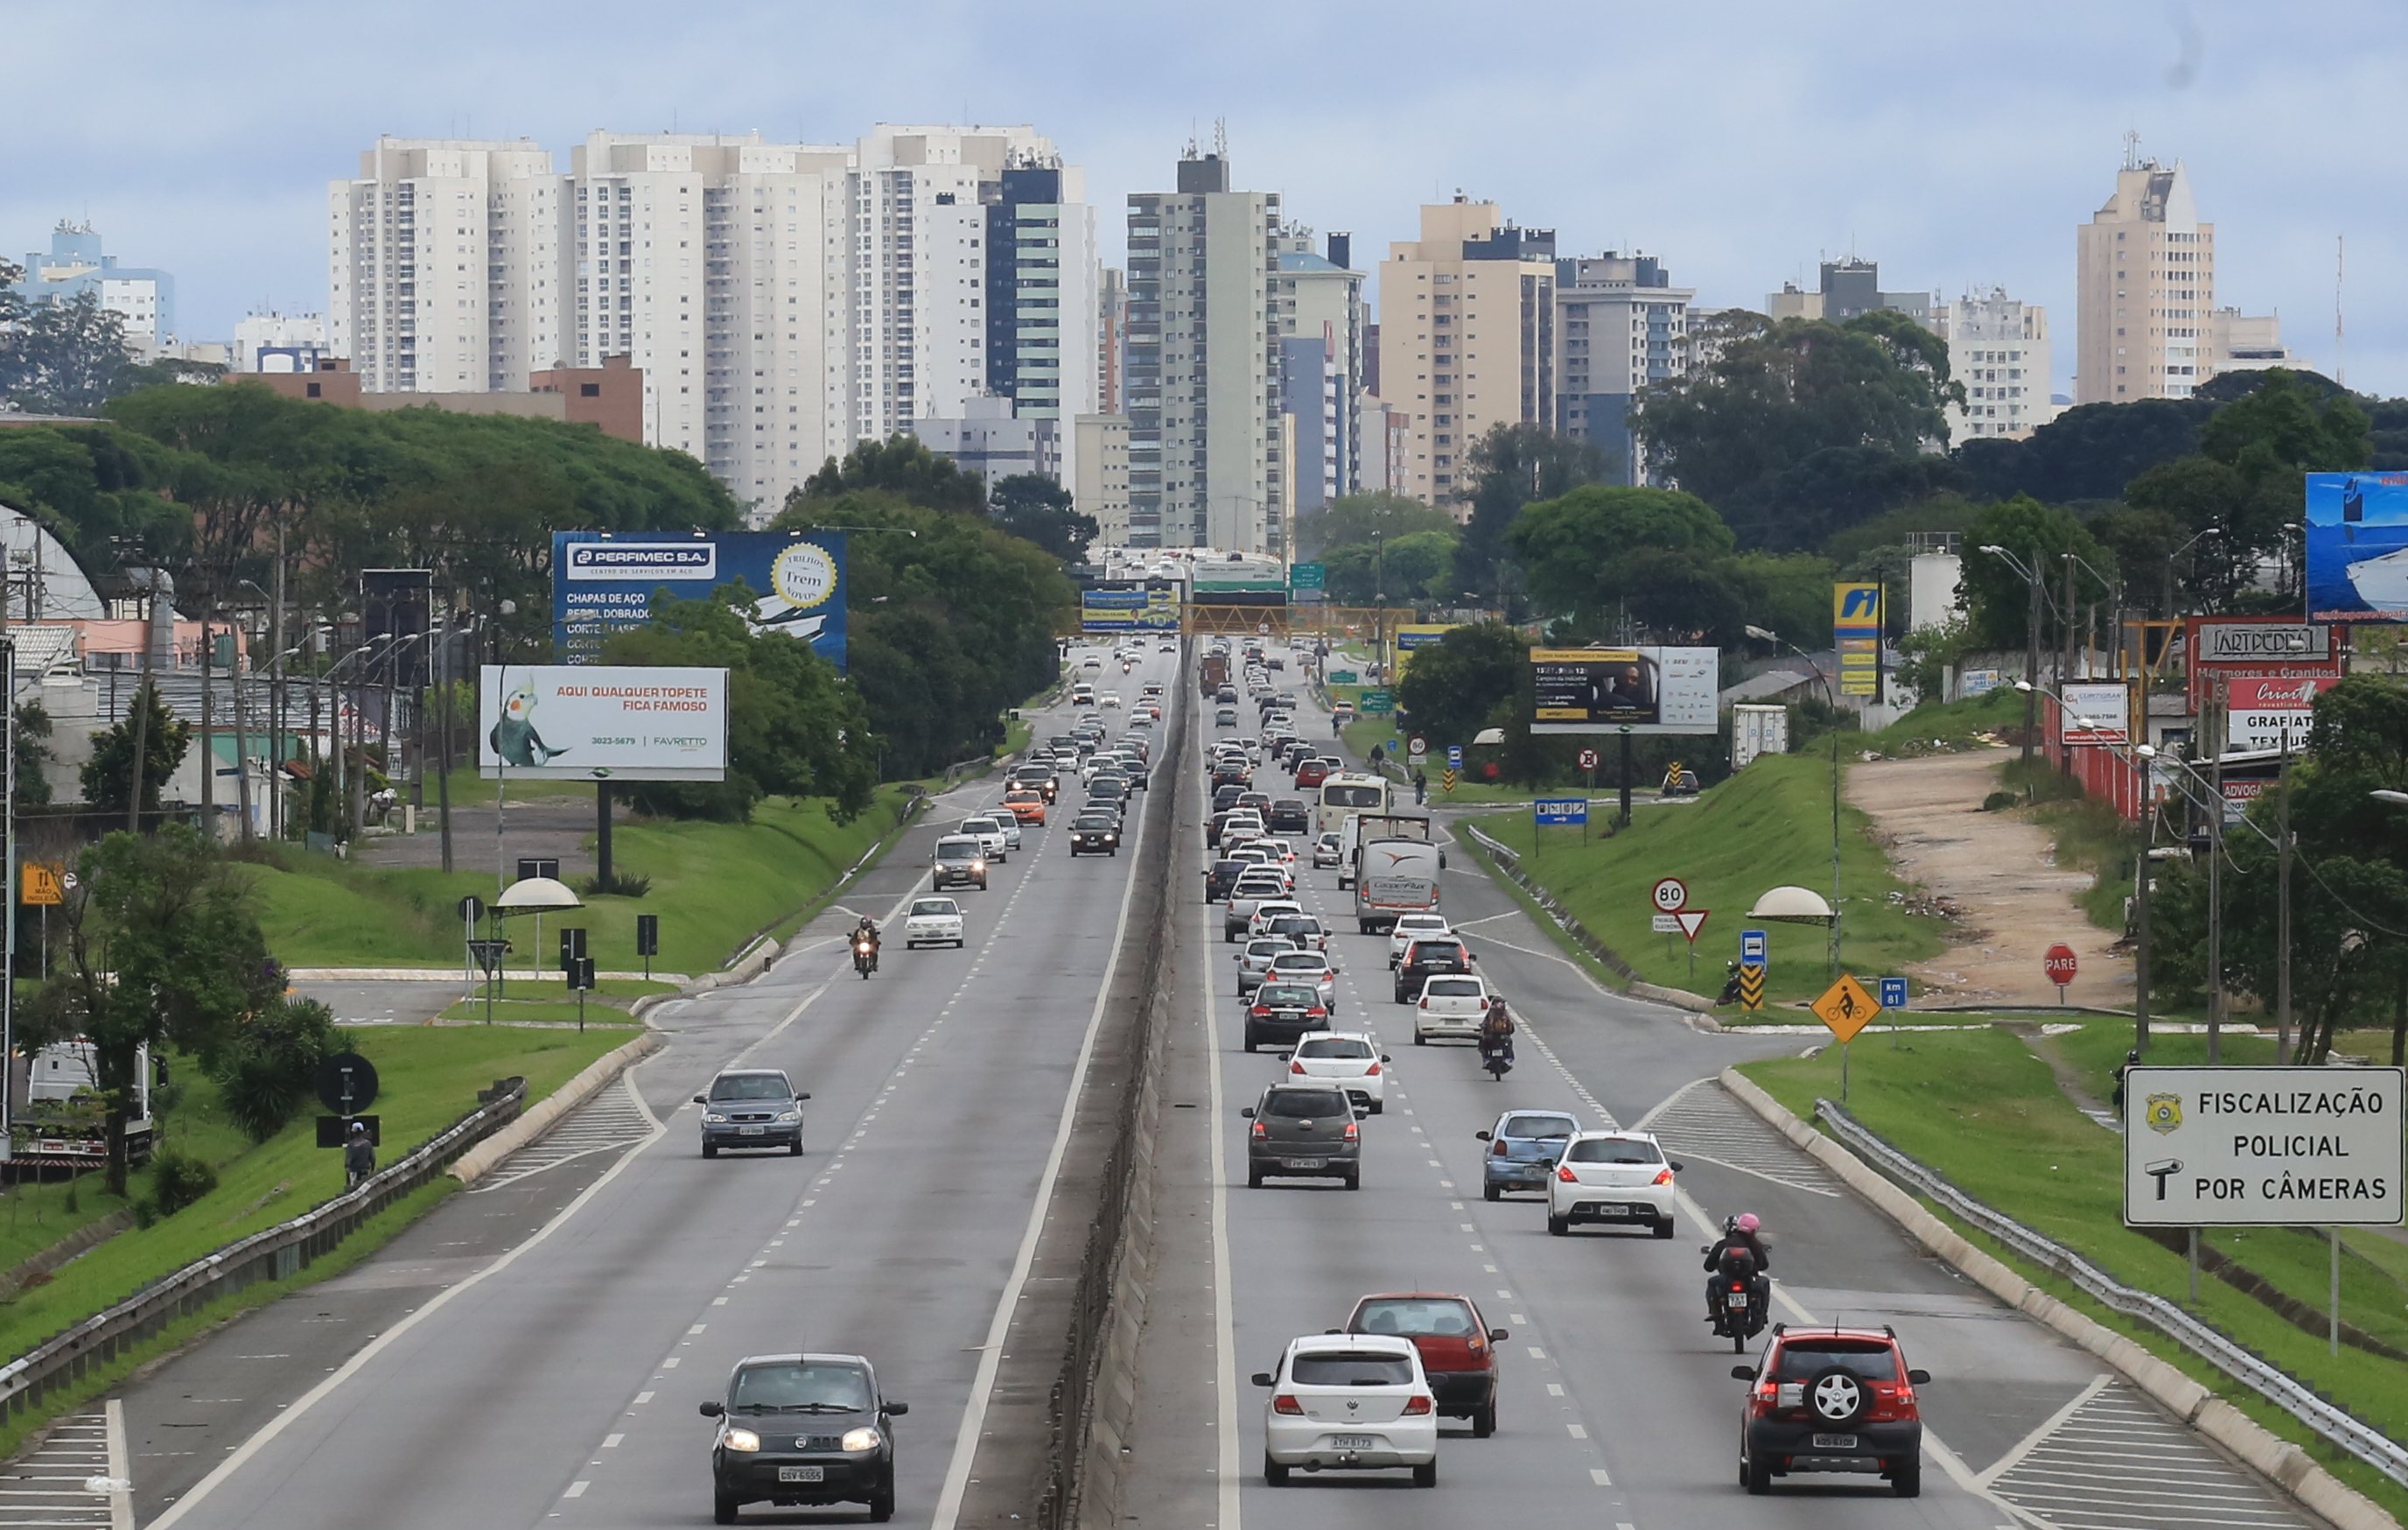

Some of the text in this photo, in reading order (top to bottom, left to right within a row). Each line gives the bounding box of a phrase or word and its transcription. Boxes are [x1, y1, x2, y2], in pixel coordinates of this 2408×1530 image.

[596, 552, 706, 562] PERFIMEC S.A.
[785, 572, 822, 586] Trem
[567, 593, 646, 605] CHAPAS DE AÇO
[2280, 667, 2336, 677] Granitos
[556, 686, 707, 698] AQUI QUALQUER TOPETE
[623, 700, 707, 712] FICA FAMOSO
[654, 737, 707, 746] FAVRETTO
[1659, 887, 1680, 902] 80
[2046, 958, 2076, 971] PARE
[1886, 982, 1901, 992] km
[1886, 996, 1900, 1005] 81
[2199, 1087, 2384, 1118] FISCALIZAÇÃO
[2234, 1136, 2349, 1157] POLICIAL
[2195, 1170, 2387, 1199] POR CÂMERAS
